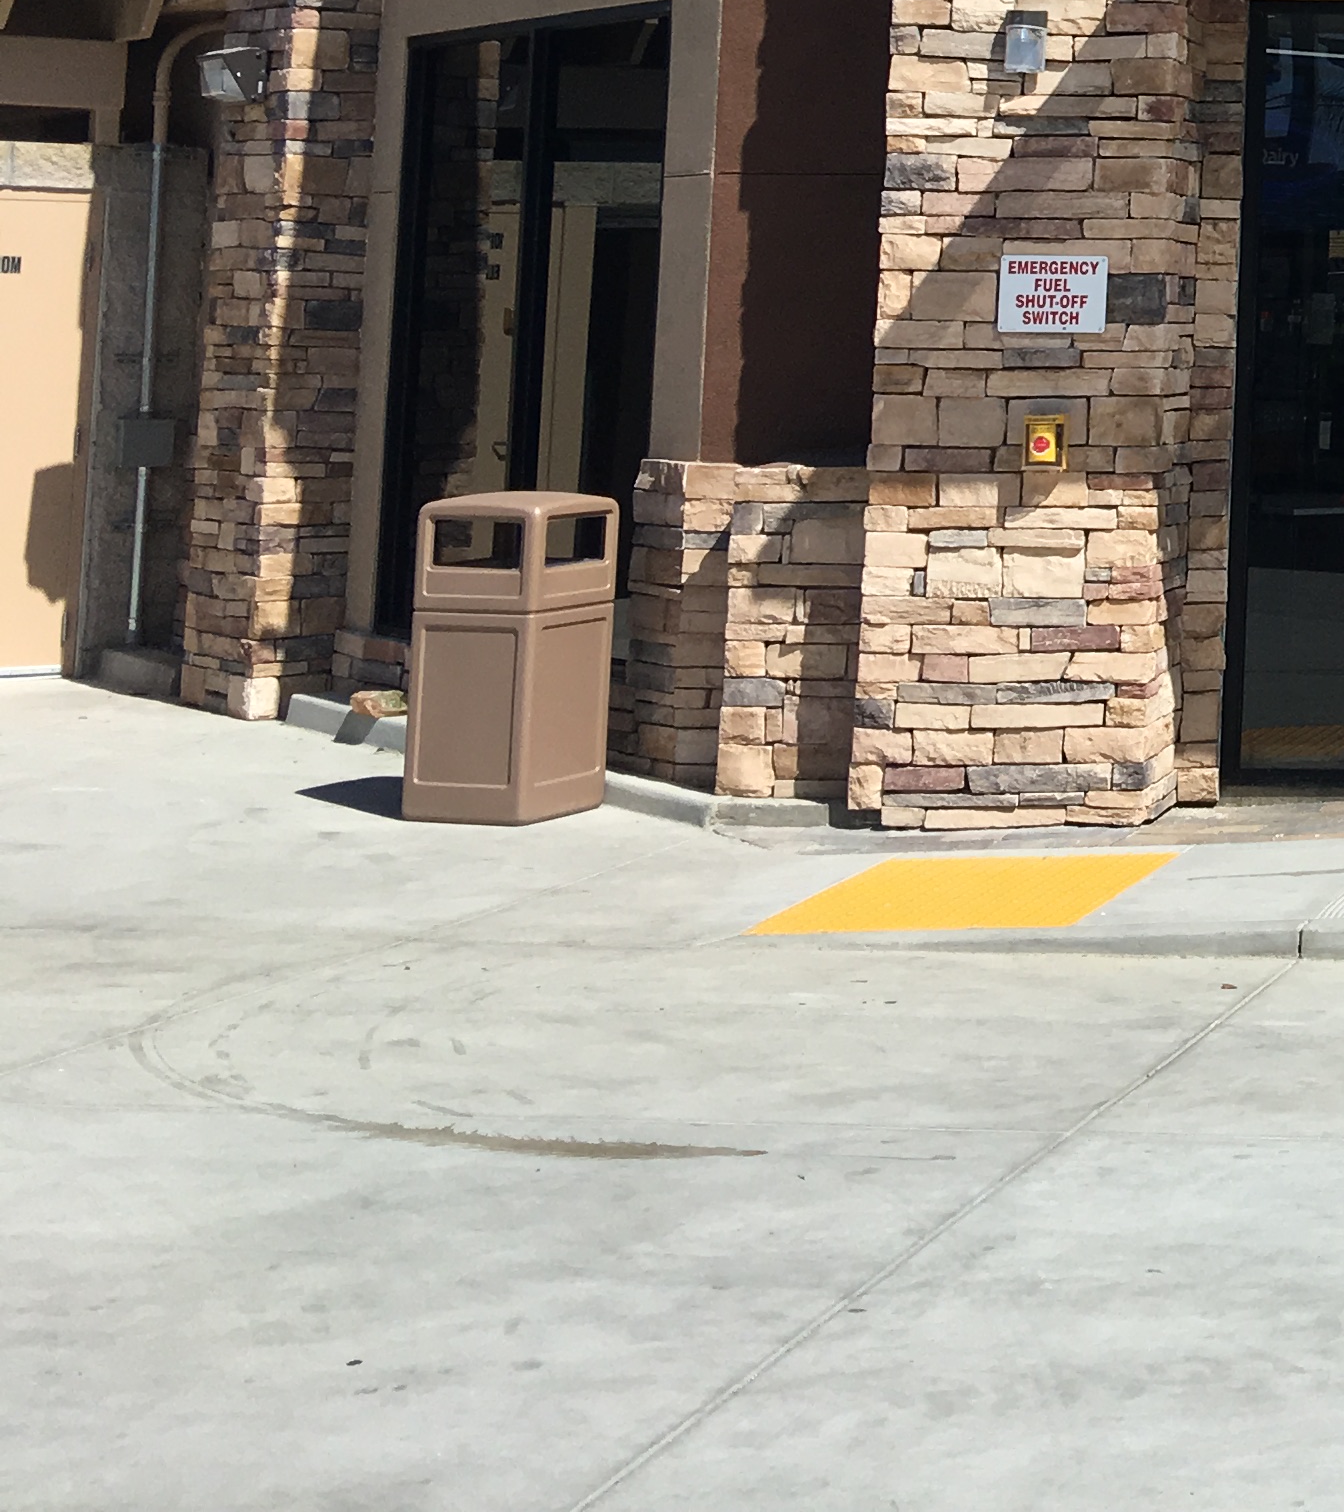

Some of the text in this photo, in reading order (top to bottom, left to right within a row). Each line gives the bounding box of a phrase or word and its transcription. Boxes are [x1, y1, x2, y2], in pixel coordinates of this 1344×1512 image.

[1008, 261, 1100, 275] EMERGENCY
[1034, 278, 1071, 292] FUEL
[1015, 294, 1088, 309] SHUT-OFF
[1022, 311, 1080, 325] SWITCH
